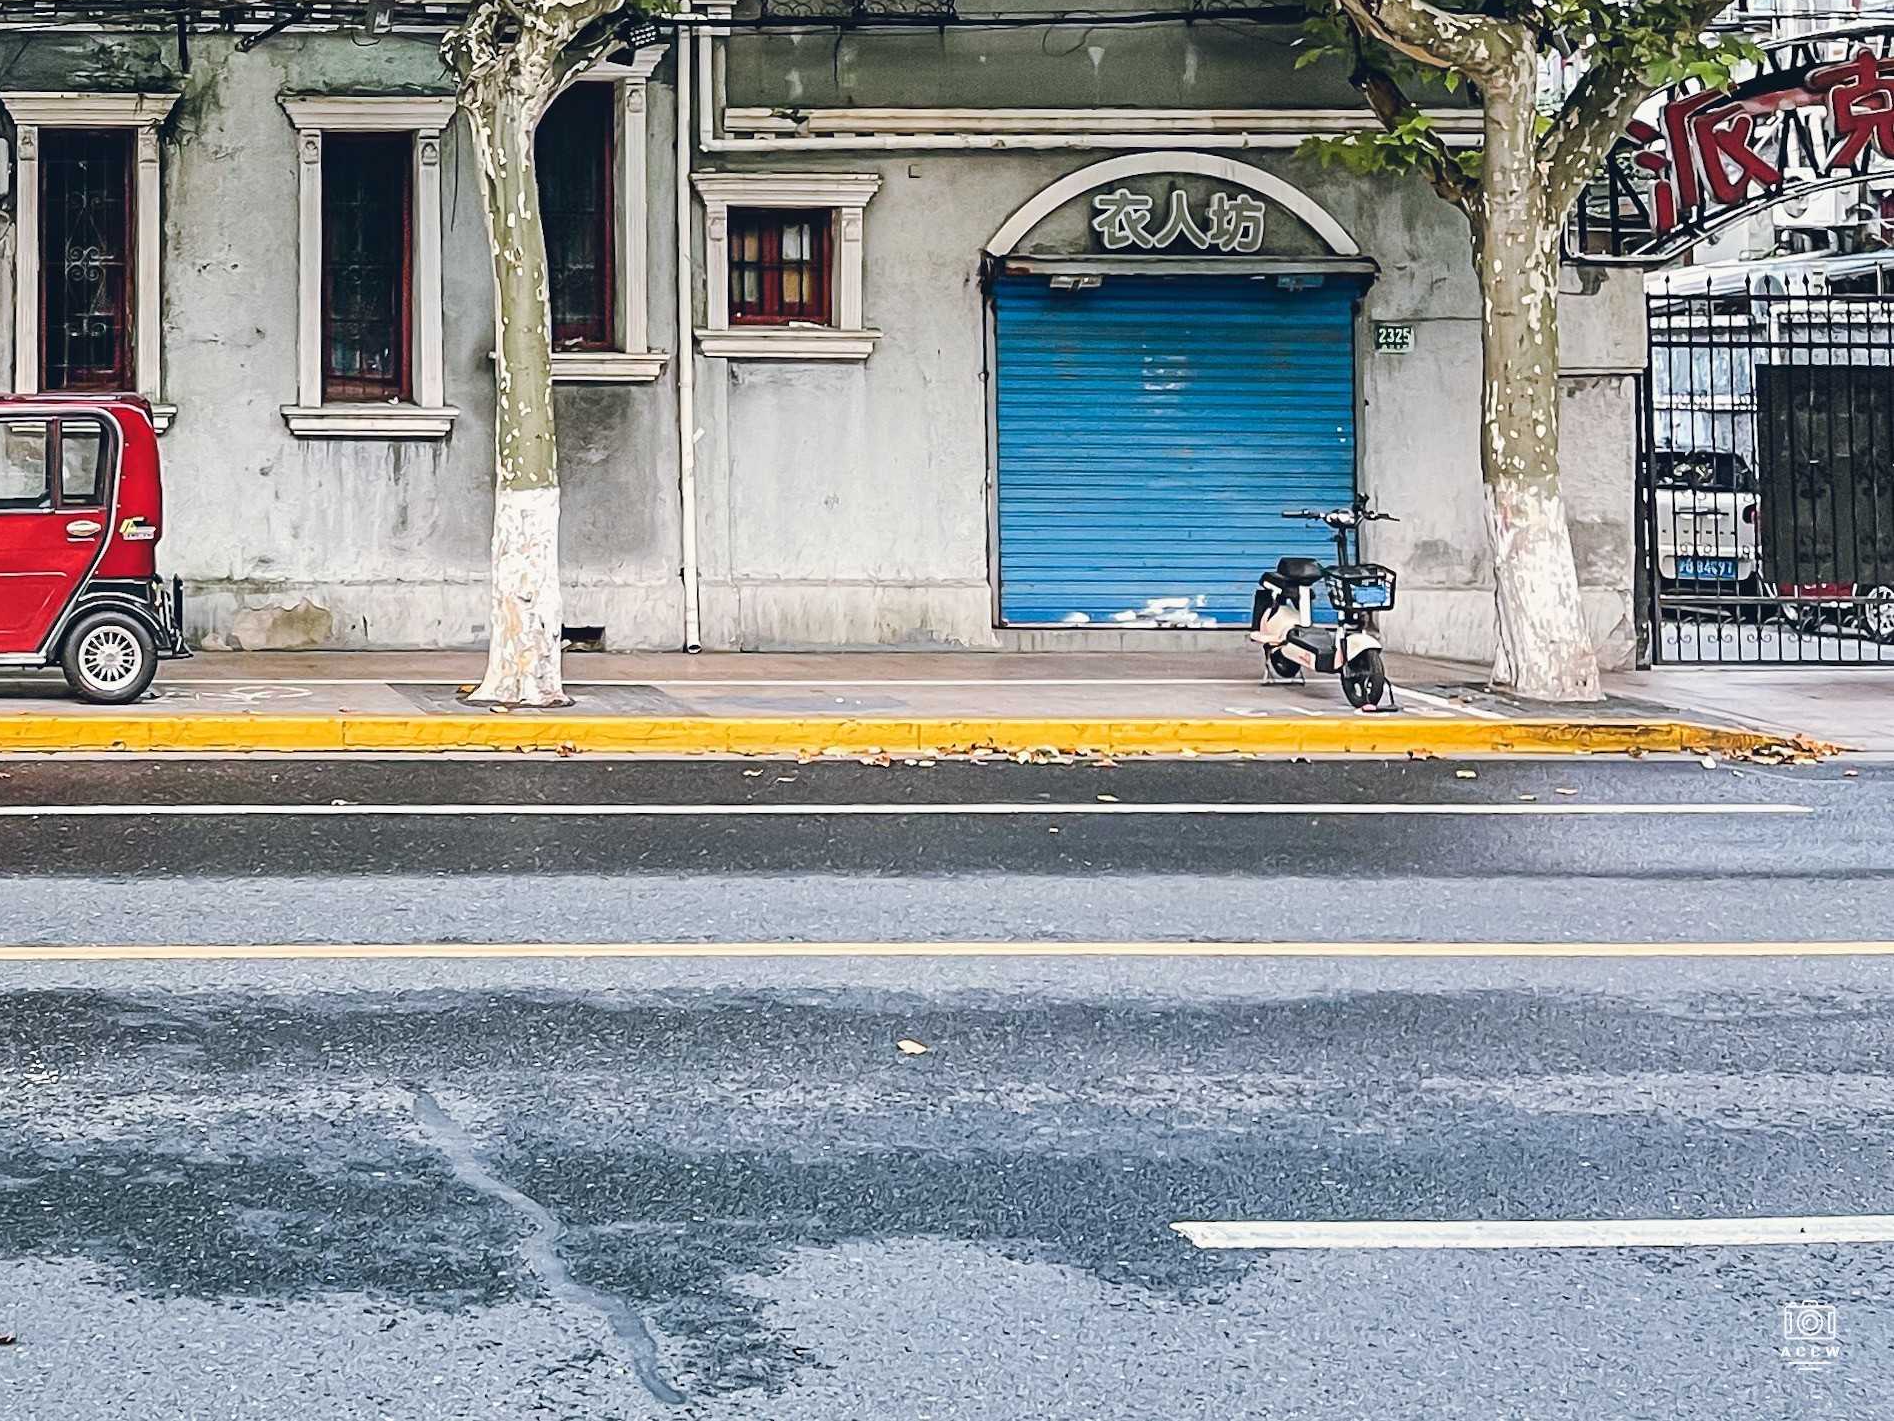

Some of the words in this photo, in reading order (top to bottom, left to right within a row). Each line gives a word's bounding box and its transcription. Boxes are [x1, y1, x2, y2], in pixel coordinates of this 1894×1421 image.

[1092, 188, 1265, 252] 衣人坊
[1378, 328, 1411, 343] 2325
